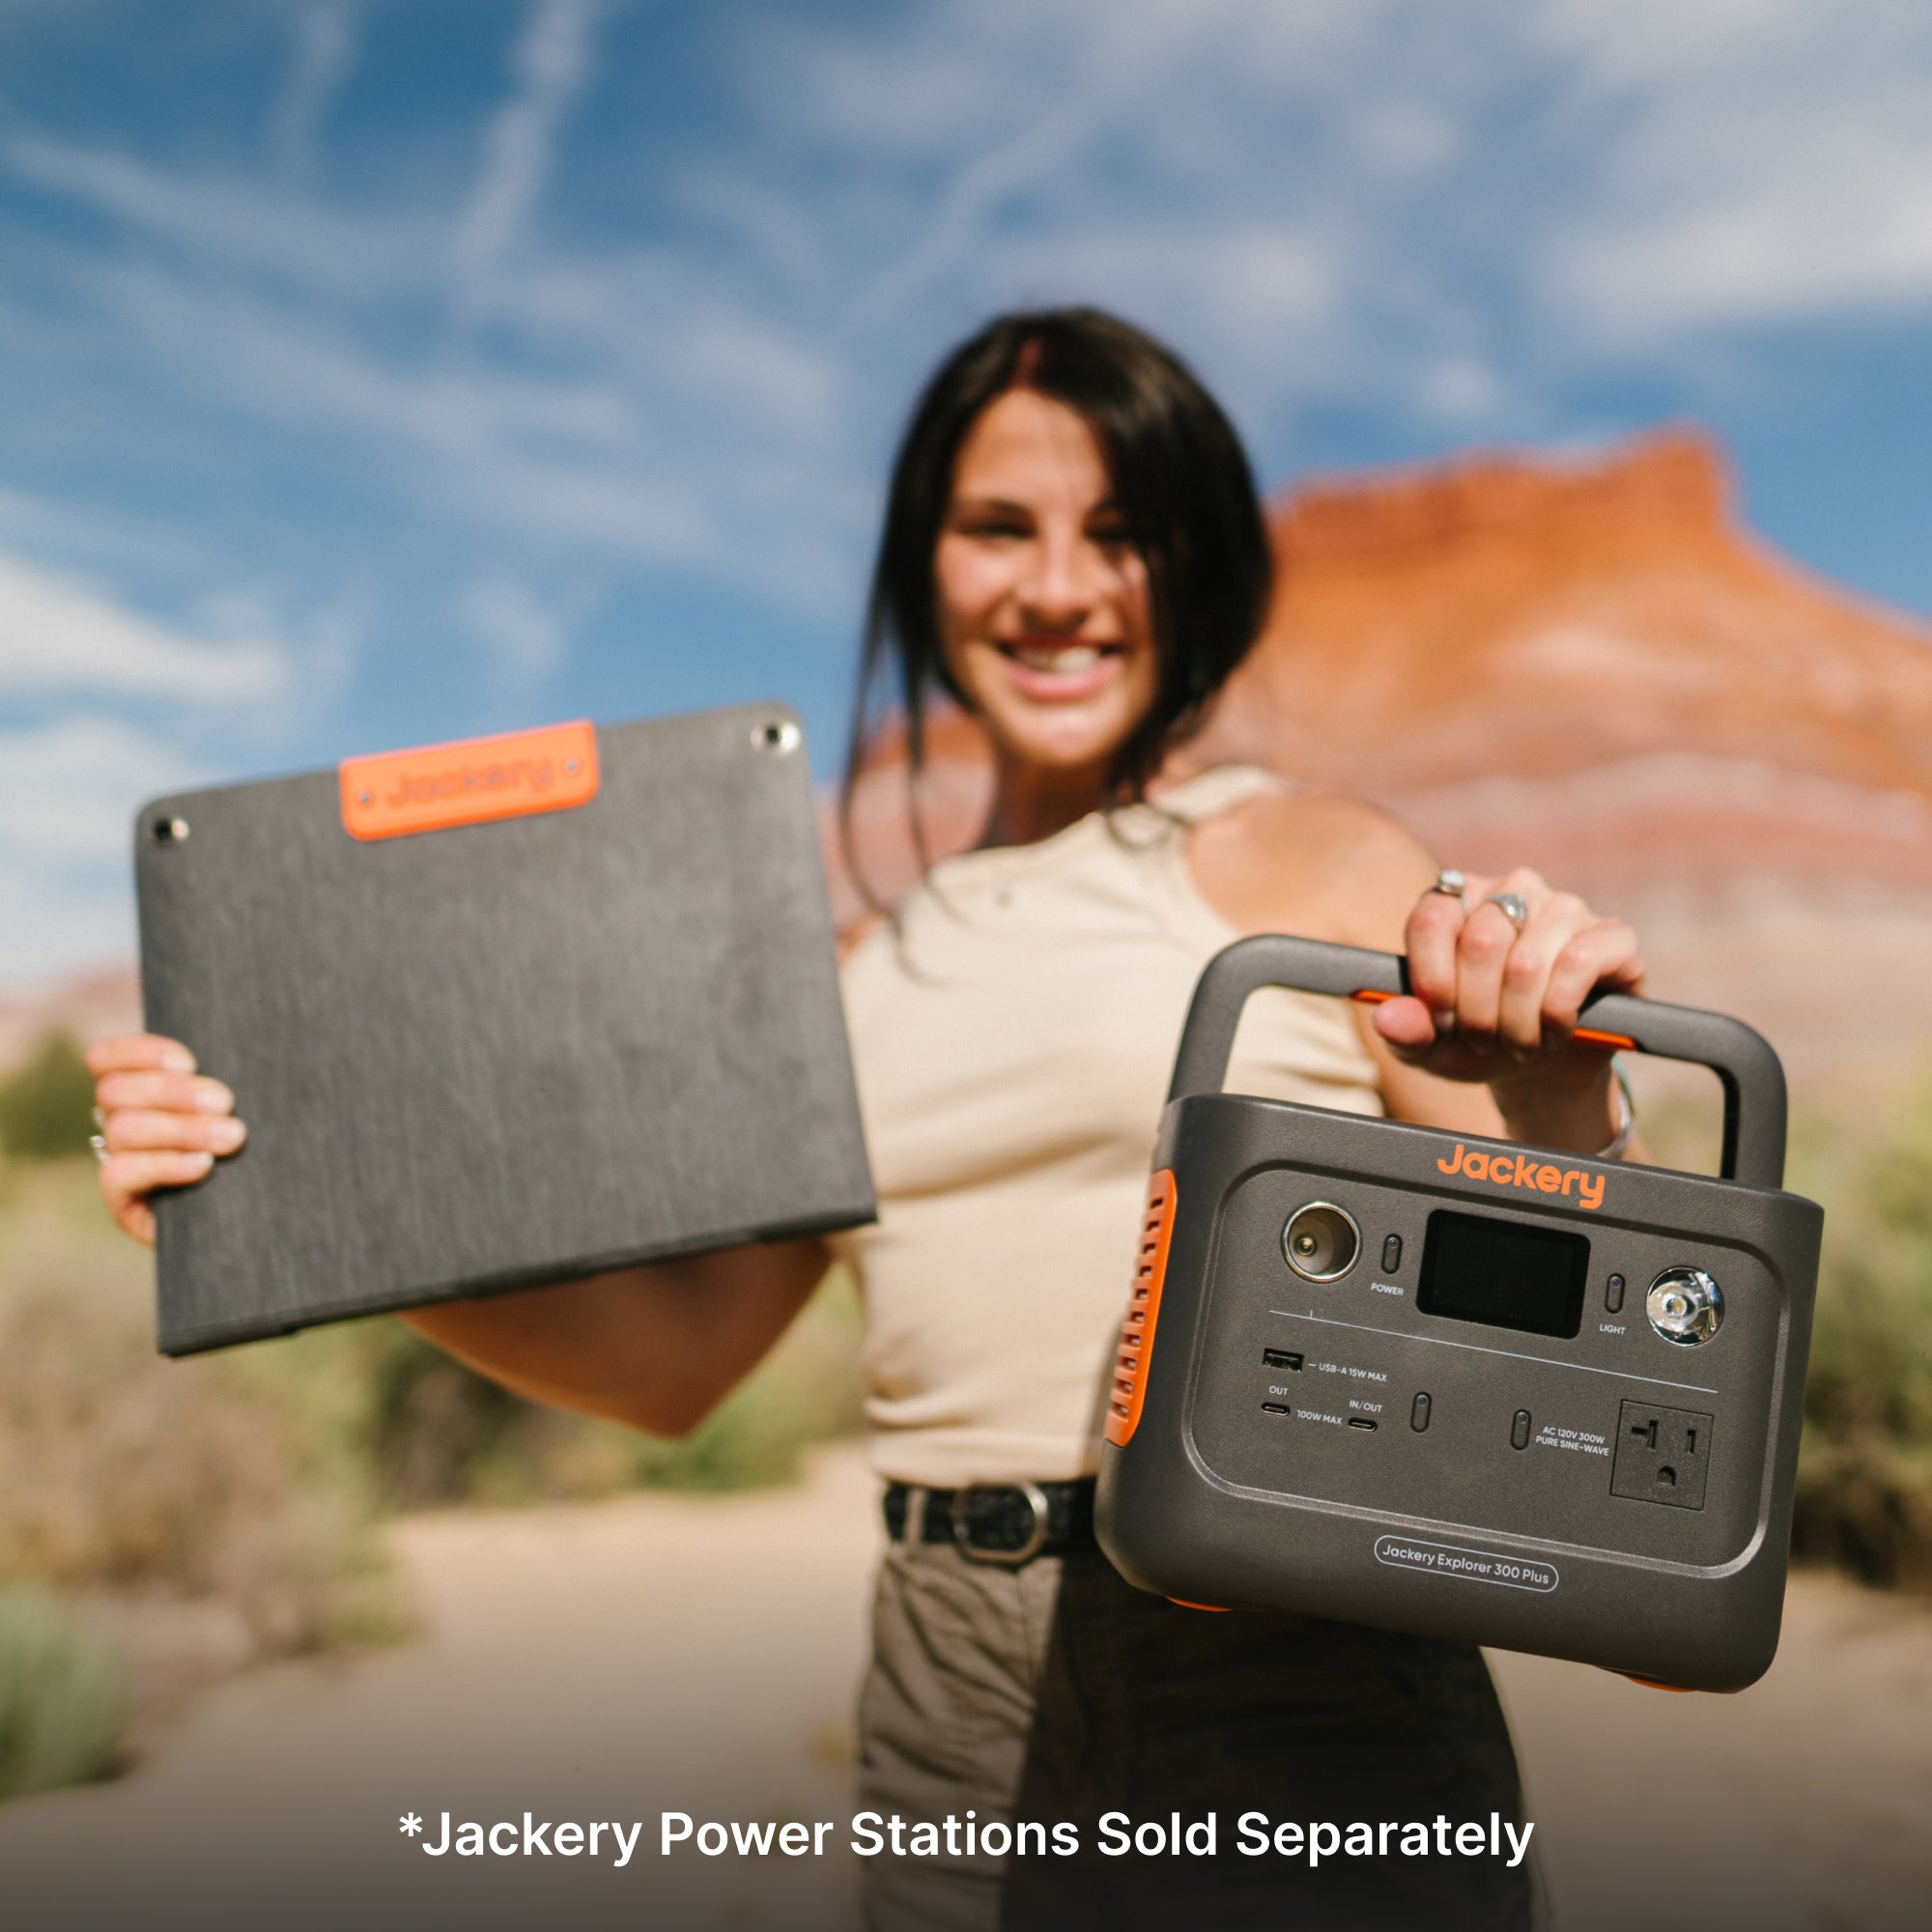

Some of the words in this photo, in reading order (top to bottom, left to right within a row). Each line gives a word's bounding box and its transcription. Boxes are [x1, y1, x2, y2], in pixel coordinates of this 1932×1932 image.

[1437, 1145, 1605, 1209] Jackery
[1371, 1283, 1404, 1296] POWER
[1600, 1323, 1626, 1335] LIGHT
[1319, 1363, 1347, 1375] USB-A
[1349, 1368, 1367, 1378] 15W
[1367, 1372, 1387, 1382] MAX
[1268, 1385, 1289, 1396] OUT
[1349, 1400, 1383, 1413] IN/OUT
[1296, 1409, 1322, 1421] 100W
[1322, 1414, 1343, 1425] MAX
[1543, 1426, 1555, 1435] AC
[1557, 1428, 1577, 1439] 120V
[1578, 1433, 1605, 1444] 300W
[1536, 1435, 1558, 1446] PURE
[1560, 1440, 1608, 1456] SINE-WAVE
[1382, 1545, 1435, 1565] Jackery
[1437, 1553, 1492, 1574] Explorer
[1493, 1563, 1520, 1579] 300
[1521, 1569, 1549, 1584] Plus
